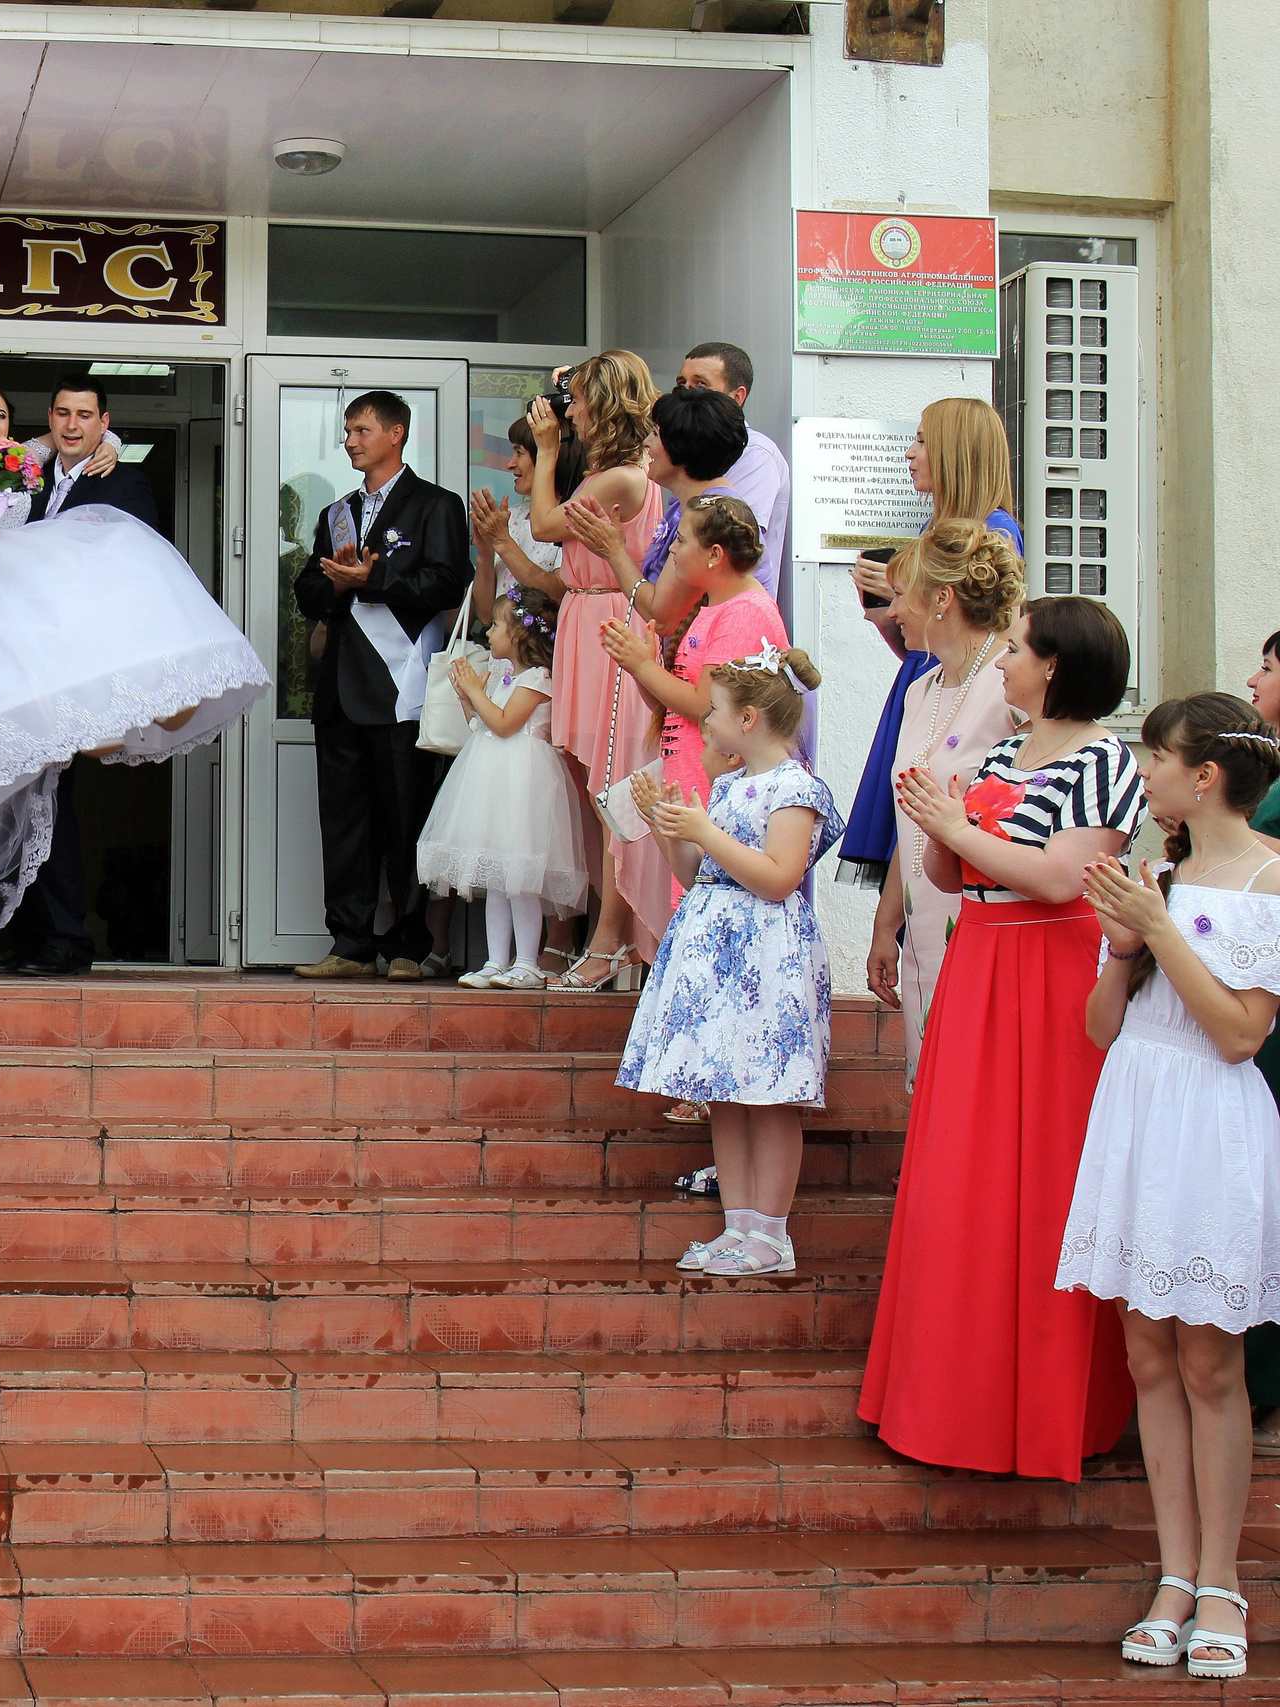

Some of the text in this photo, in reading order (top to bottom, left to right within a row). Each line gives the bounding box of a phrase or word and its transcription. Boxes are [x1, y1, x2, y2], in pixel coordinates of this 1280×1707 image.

[798, 267, 994, 282] ПРОФСОЮЗ РАБОТНИКОВ АГРОПРОМЫШЛЕННОГО
[819, 276, 973, 289] КОМПЛЕКСА РОССИЙСКОЙ ФЕДЕРАЦИИ
[805, 285, 988, 299] БЕЛОГЛИНСКАЯ РАЙОННАЯ ТЕРРИТОРИАЛЬНАЯ
[808, 293, 864, 301] ОРГАНИЗАЦИЯ
[868, 295, 954, 305] ПРОФЕССИОНАЛЬНОГО
[800, 300, 993, 314] РАБОТНИКОВ АГРОПРОМЫШЛЕННОГО КОМПЛЕКСА
[846, 309, 948, 319] РОССИЙСКОЙ ФЕДЕРАЦИИ
[815, 432, 871, 440] ФЕДЕРАЛЬНАЯ
[872, 434, 903, 442] СЛУЖБА
[850, 454, 883, 463] ФИЛИАЛ
[831, 465, 908, 474] ГОСУДАРСТВЕННОГО
[813, 475, 915, 486] УЧРЕЖДЕНИЯ «ФЕДЕРАЛЬН
[854, 487, 884, 495] ПАЛАТА
[814, 497, 849, 505] СЛУЖБЫ
[850, 498, 923, 507] ГОСУДАРСТВЕННОЙ
[844, 509, 883, 517] КАДАСТРА
